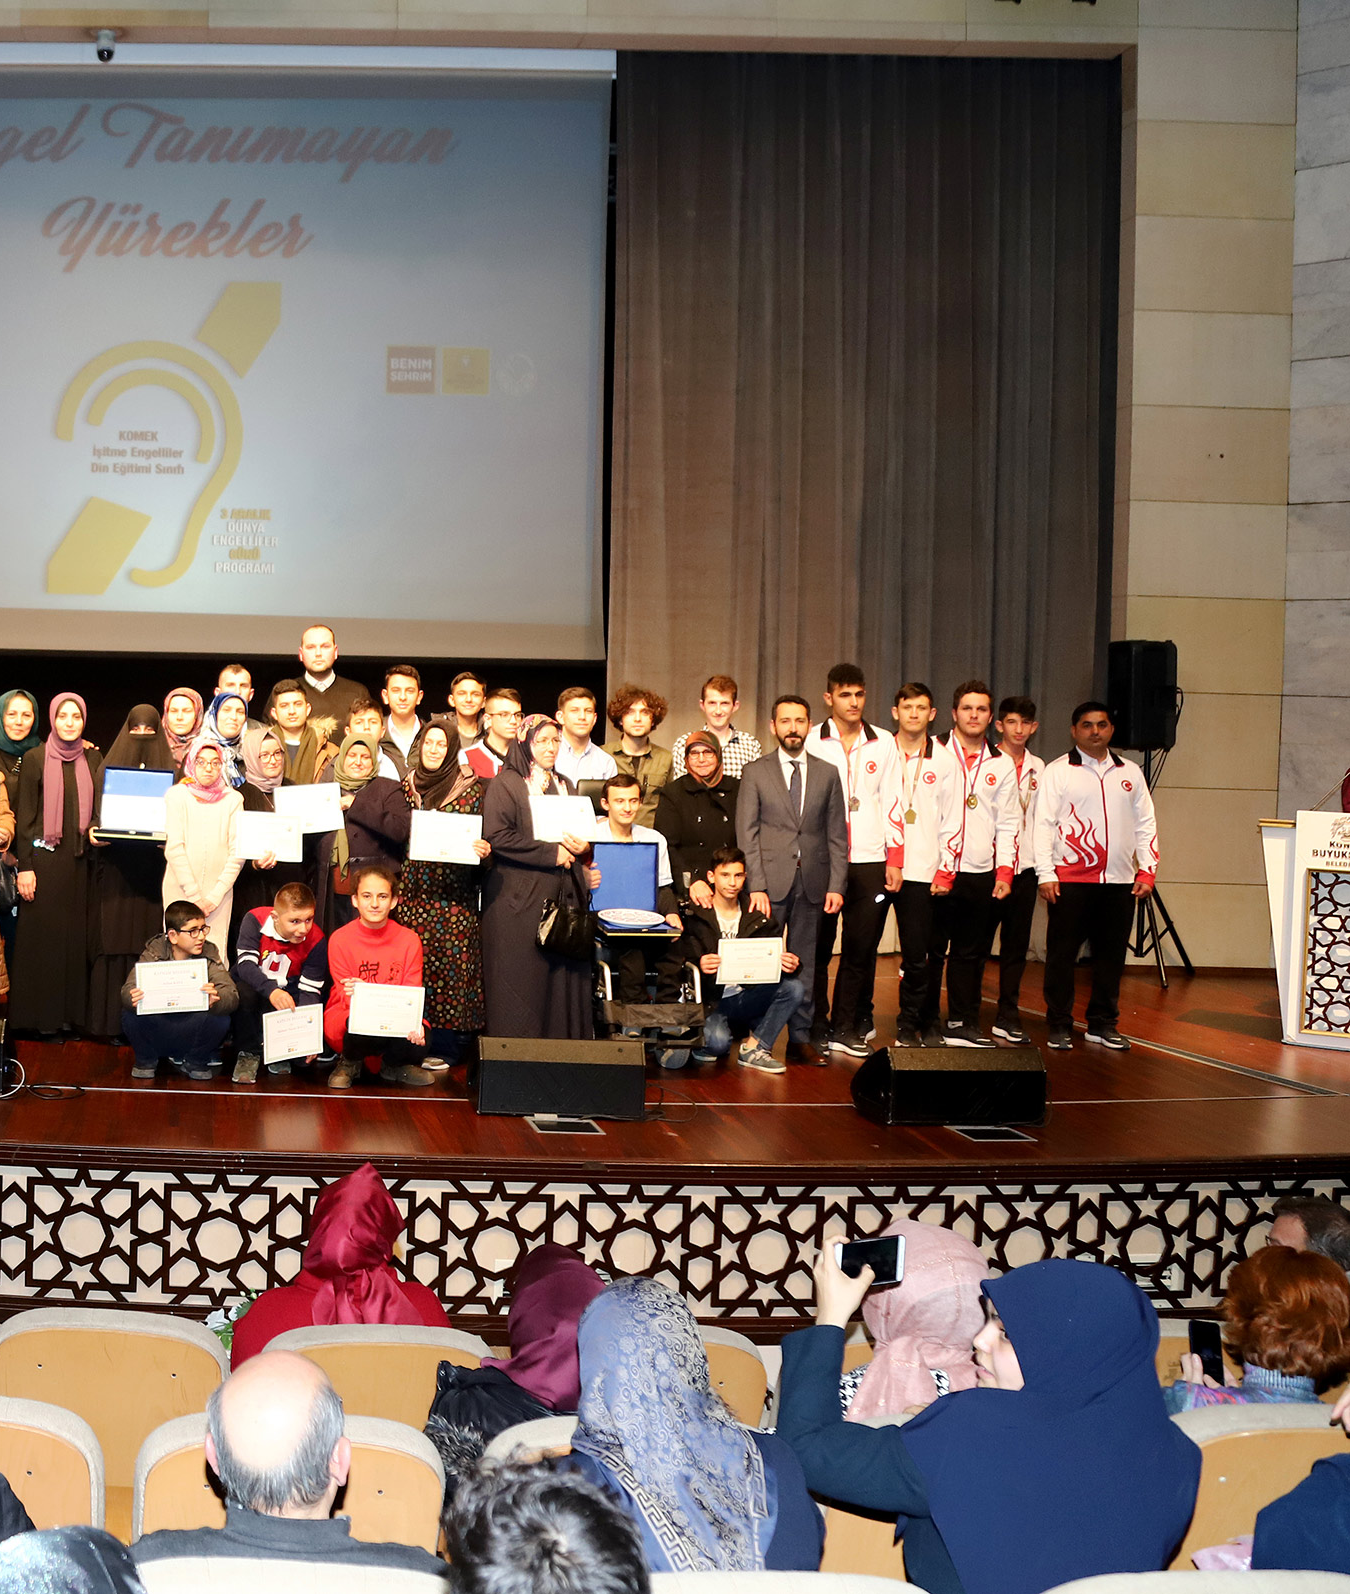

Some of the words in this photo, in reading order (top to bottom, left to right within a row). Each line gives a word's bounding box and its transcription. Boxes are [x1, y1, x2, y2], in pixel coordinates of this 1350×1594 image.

[101, 102, 454, 183] Tanımayan
[41, 196, 315, 273] Yürekler
[119, 430, 158, 441] KOMEK
[92, 444, 127, 459] İşitme
[130, 447, 184, 460] Engelliler
[91, 463, 109, 473] Din
[113, 462, 151, 475] Eğitimi
[214, 561, 275, 574] PROGRAMI
